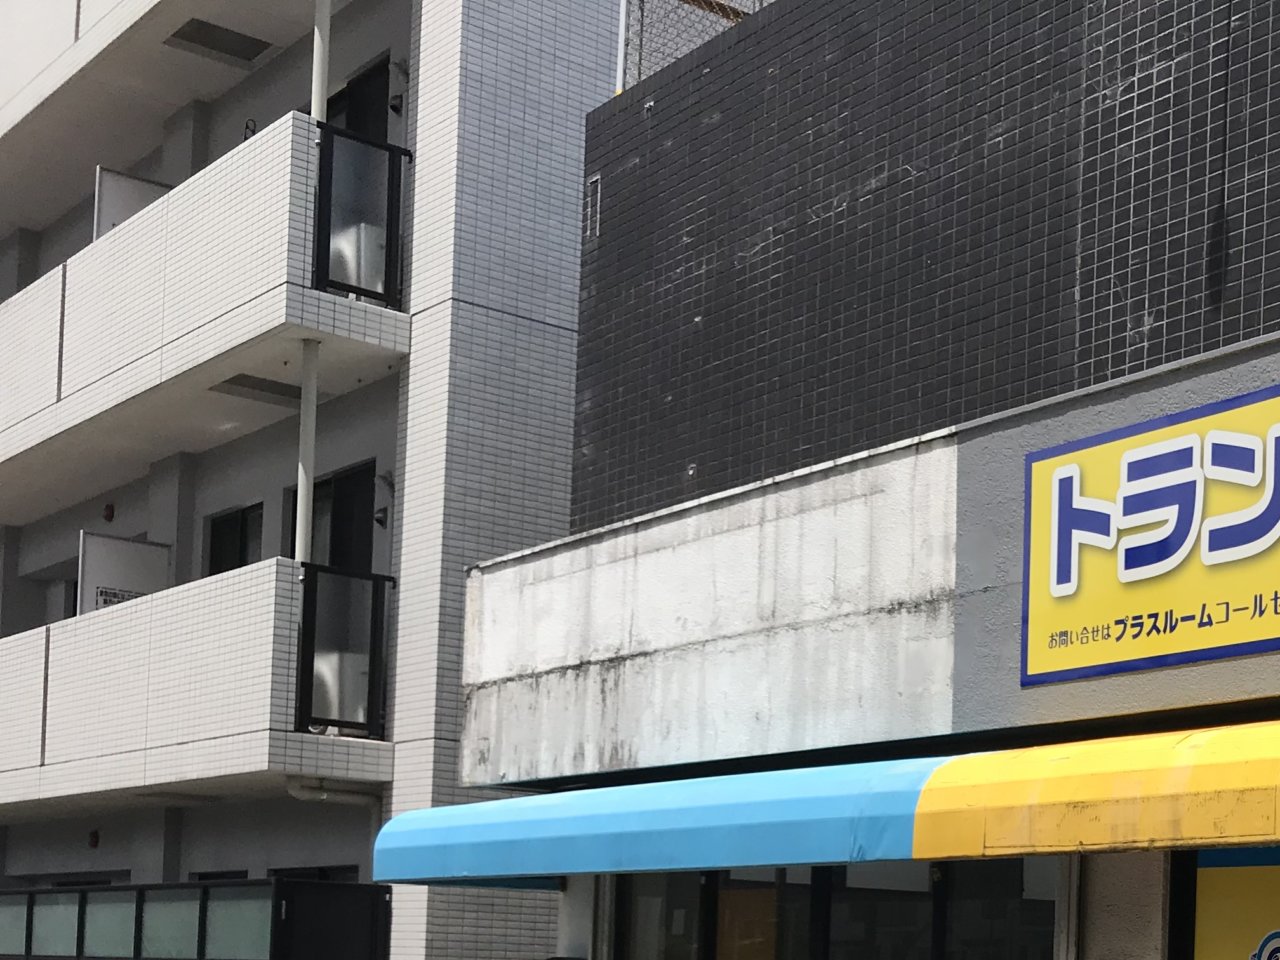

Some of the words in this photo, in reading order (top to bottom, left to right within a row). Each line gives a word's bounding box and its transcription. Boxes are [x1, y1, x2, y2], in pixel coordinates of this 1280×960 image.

[1048, 623, 1112, 650] お問い合せは
